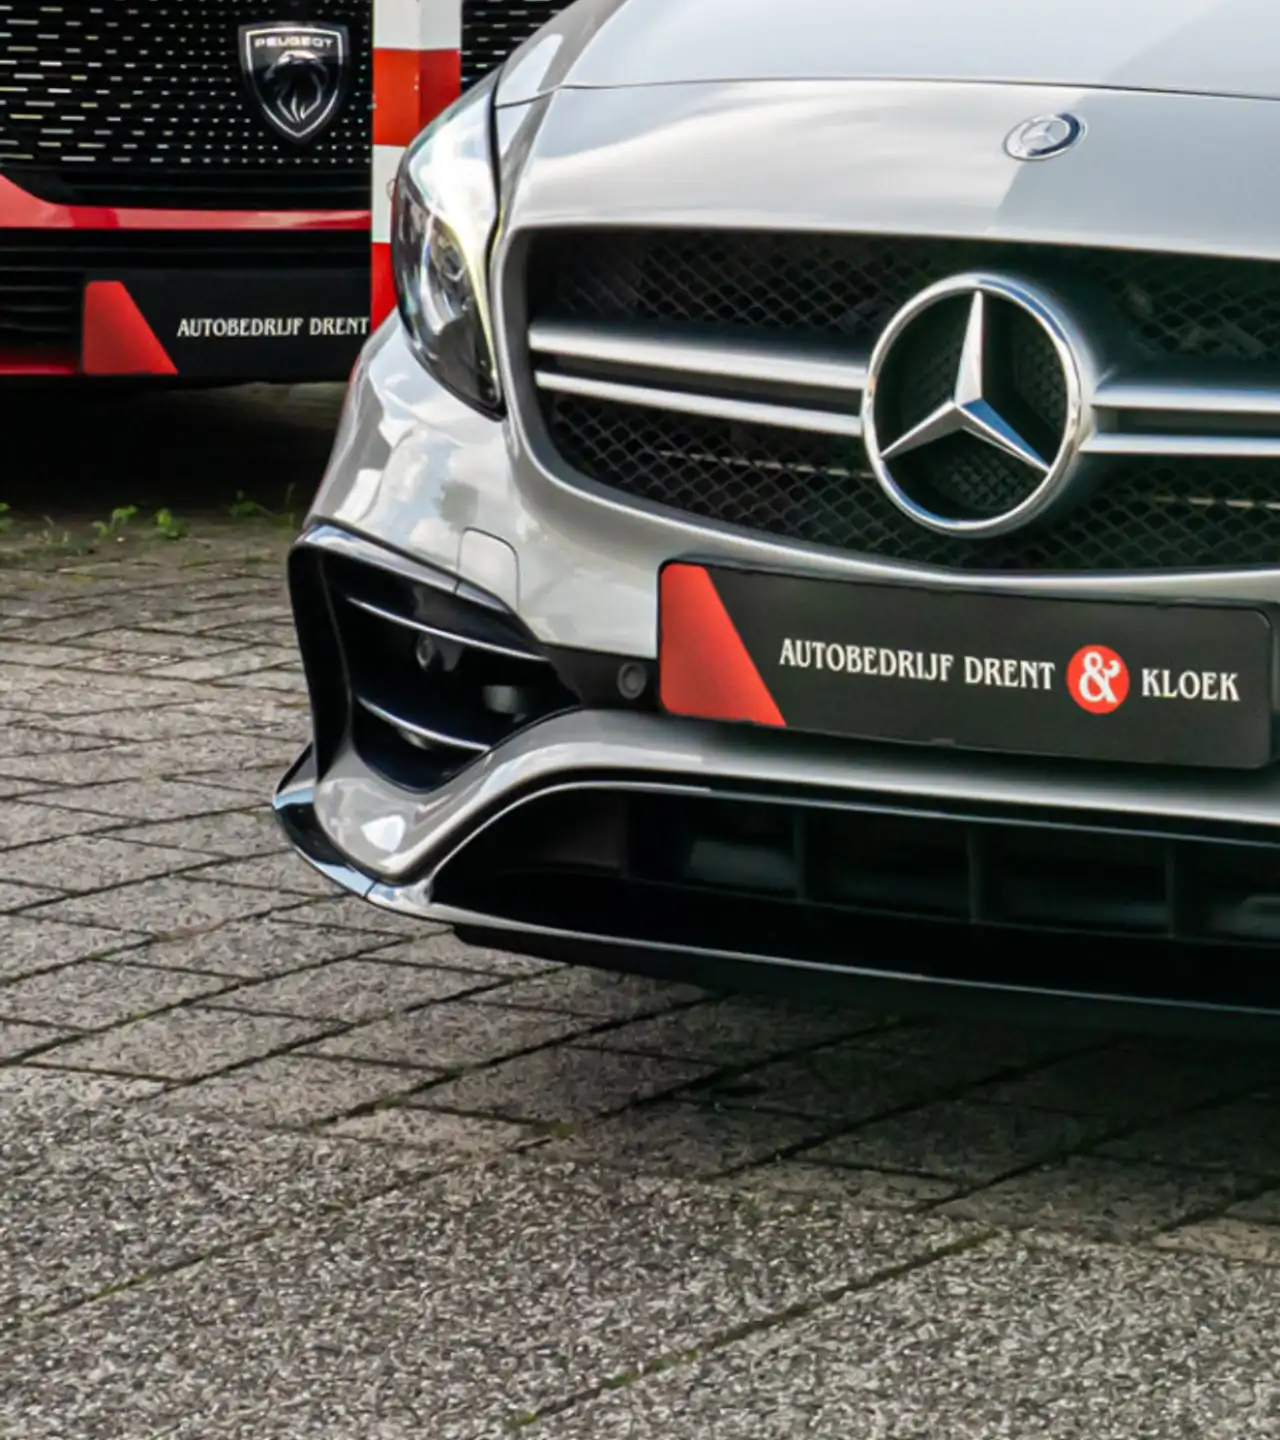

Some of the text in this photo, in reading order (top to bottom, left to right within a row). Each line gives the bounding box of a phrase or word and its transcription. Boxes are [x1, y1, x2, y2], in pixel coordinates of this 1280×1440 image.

[253, 35, 334, 49] PEUGEOT
[176, 316, 370, 338] AUTOBEDRIJF DRENT
[779, 637, 1241, 704] AUTOBEDRIJF DRENT & KLOEK
